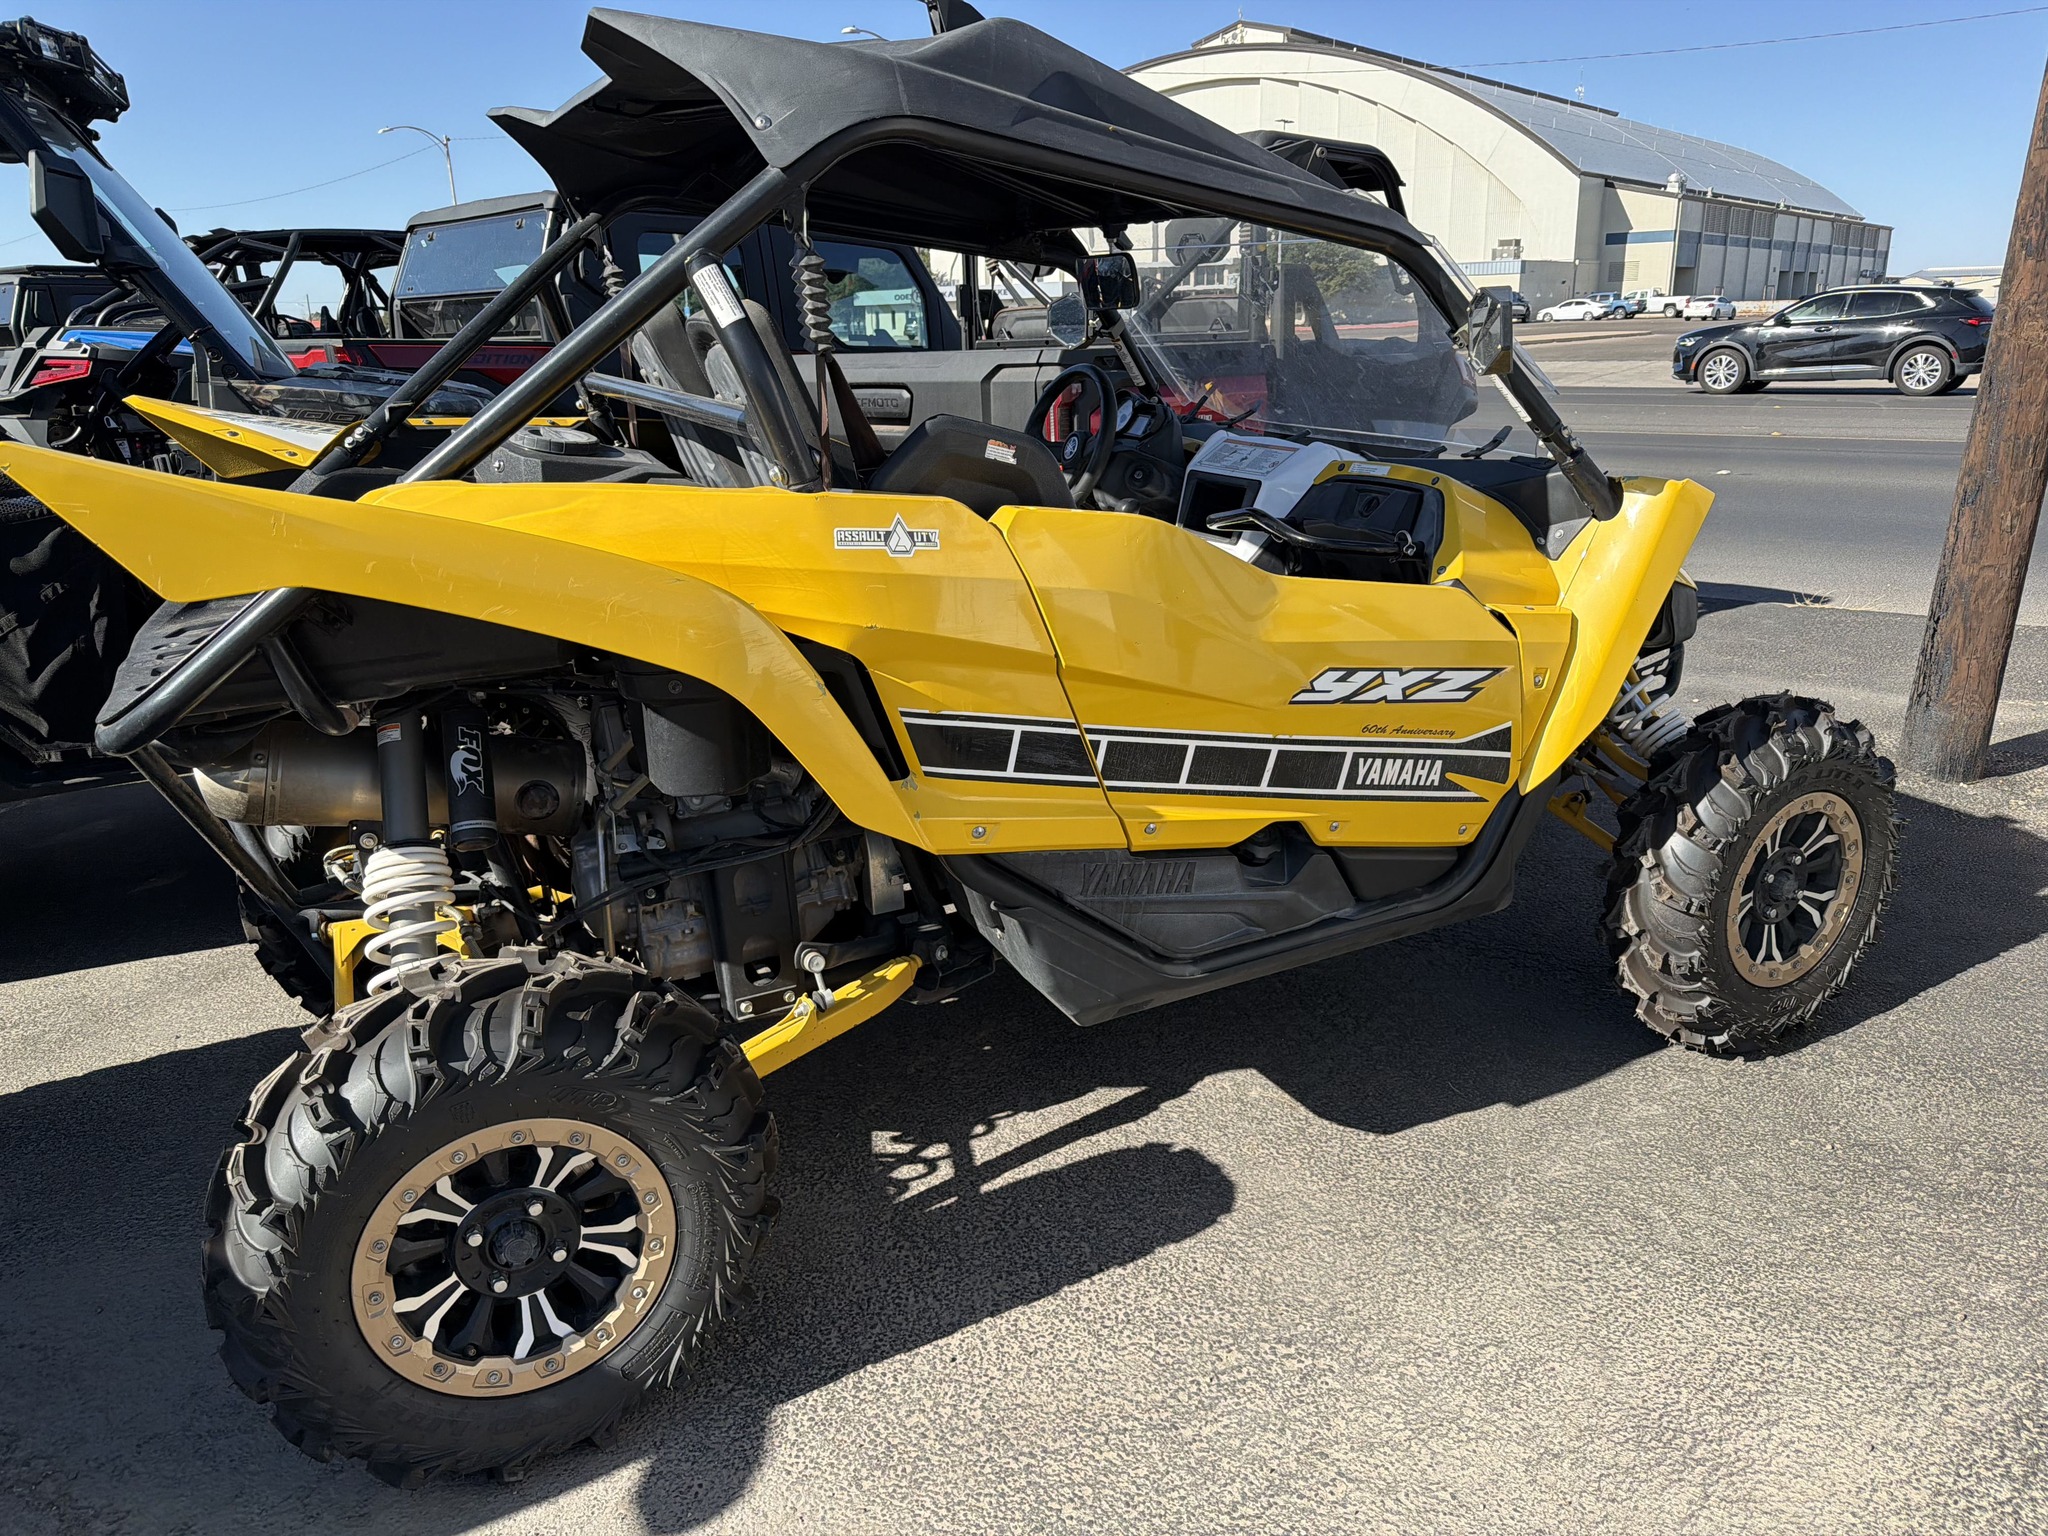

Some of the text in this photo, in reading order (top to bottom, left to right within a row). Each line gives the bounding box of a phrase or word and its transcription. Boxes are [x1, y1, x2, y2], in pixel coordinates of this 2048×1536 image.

[837, 530, 937, 542] ASSAULT UTV
[1289, 667, 1507, 704] YXZ
[1361, 723, 1457, 738] 60th Anniversary
[450, 726, 485, 796] FOX
[1356, 757, 1443, 786] YAMAHA
[1080, 861, 1197, 897] YAMAHA
